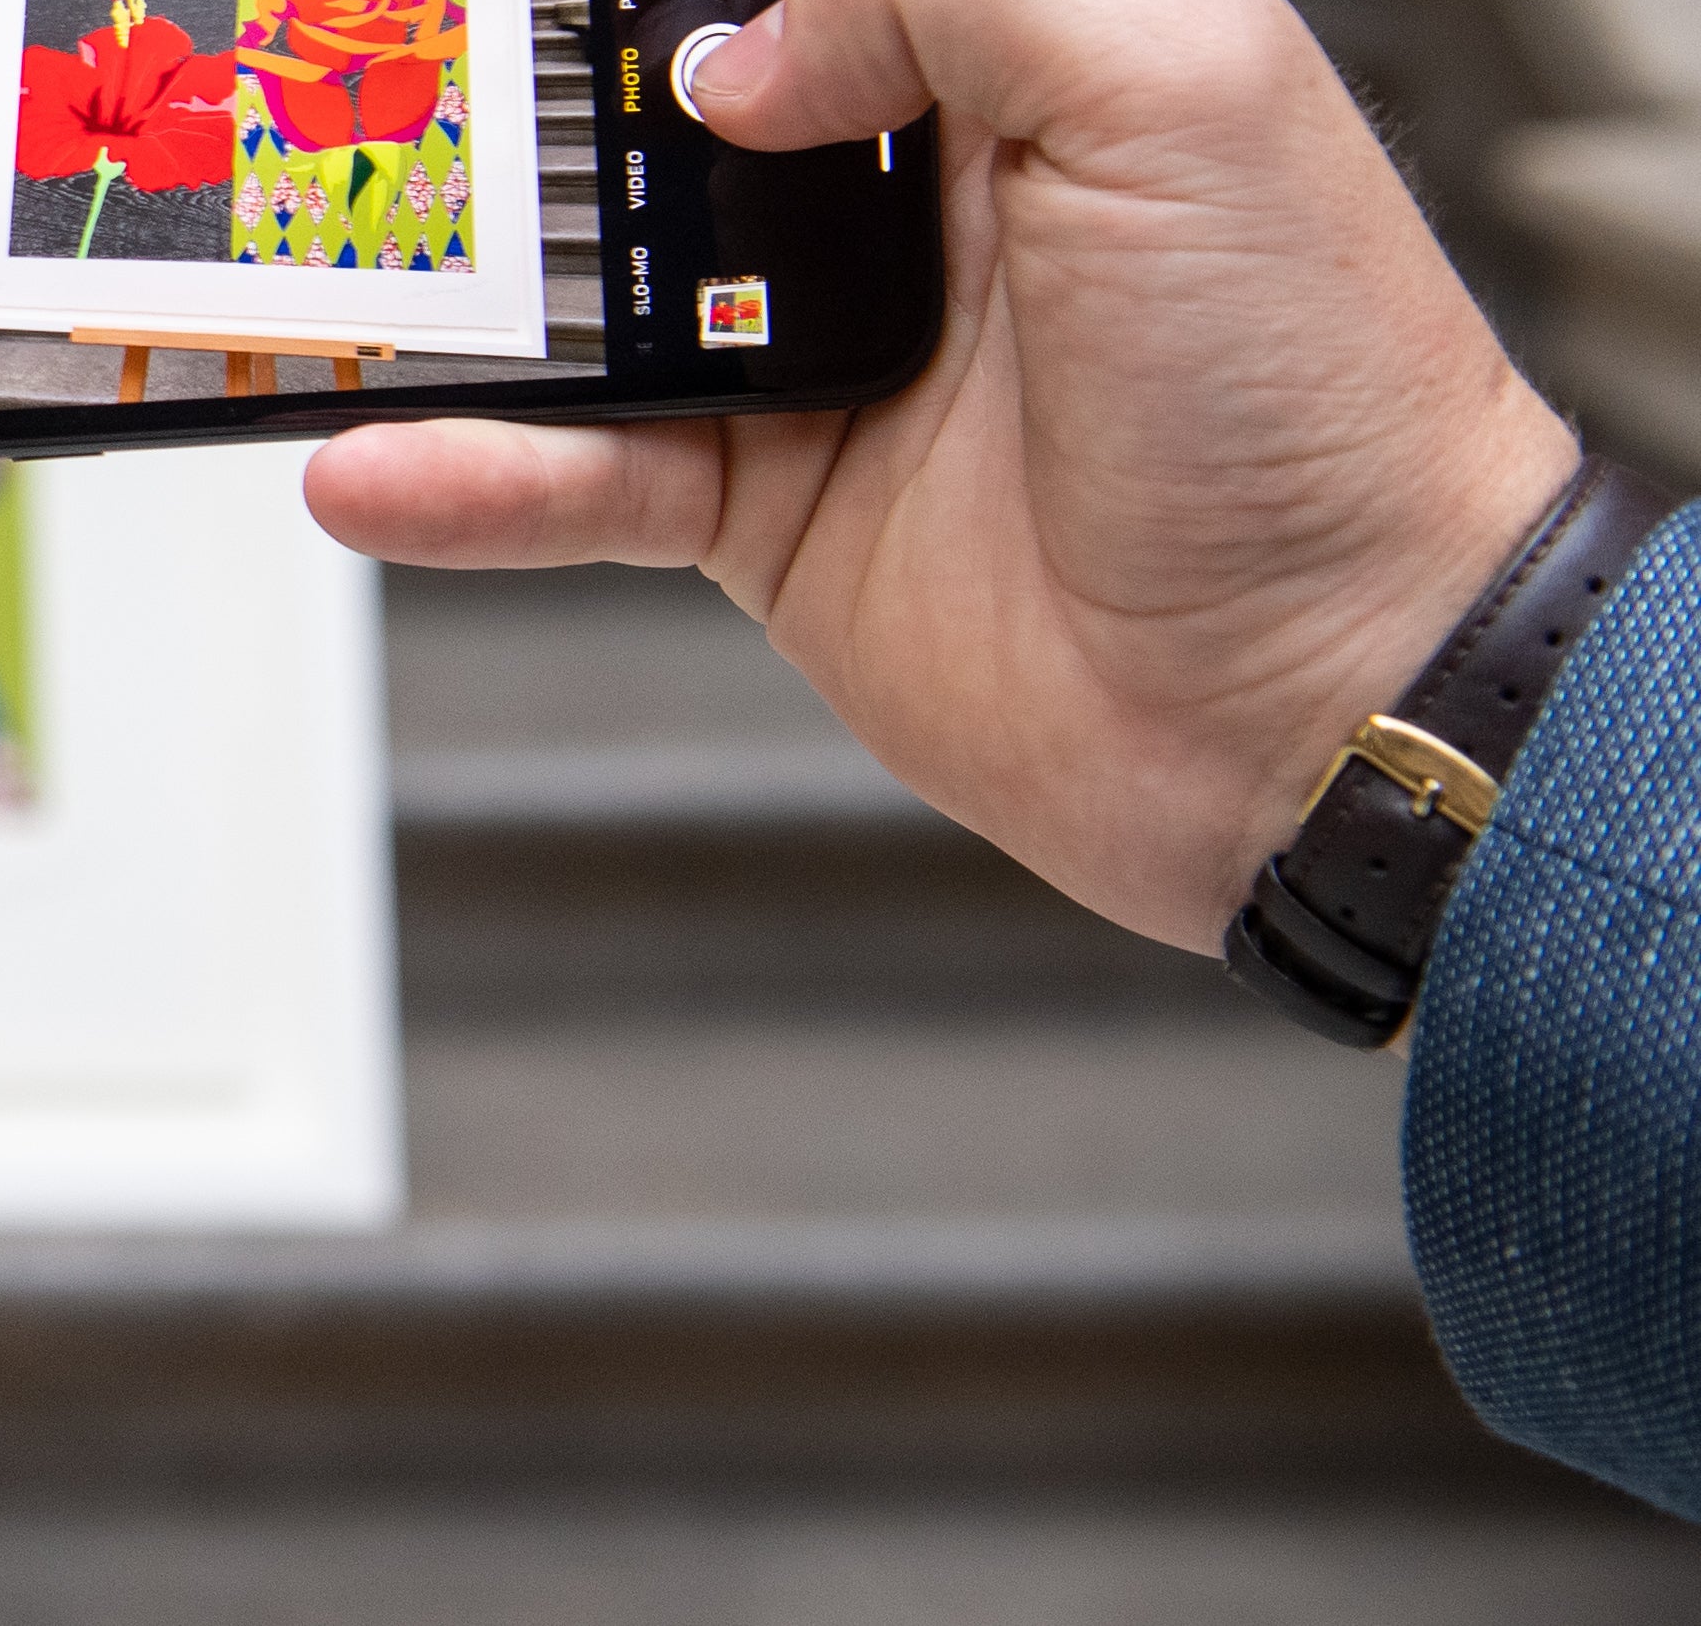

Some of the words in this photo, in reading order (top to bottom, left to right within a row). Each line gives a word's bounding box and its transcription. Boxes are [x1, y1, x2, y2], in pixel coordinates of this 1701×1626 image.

[621, 47, 641, 112] PHOTO
[626, 150, 647, 210] VIDEO
[631, 246, 651, 316] SLO-MO
